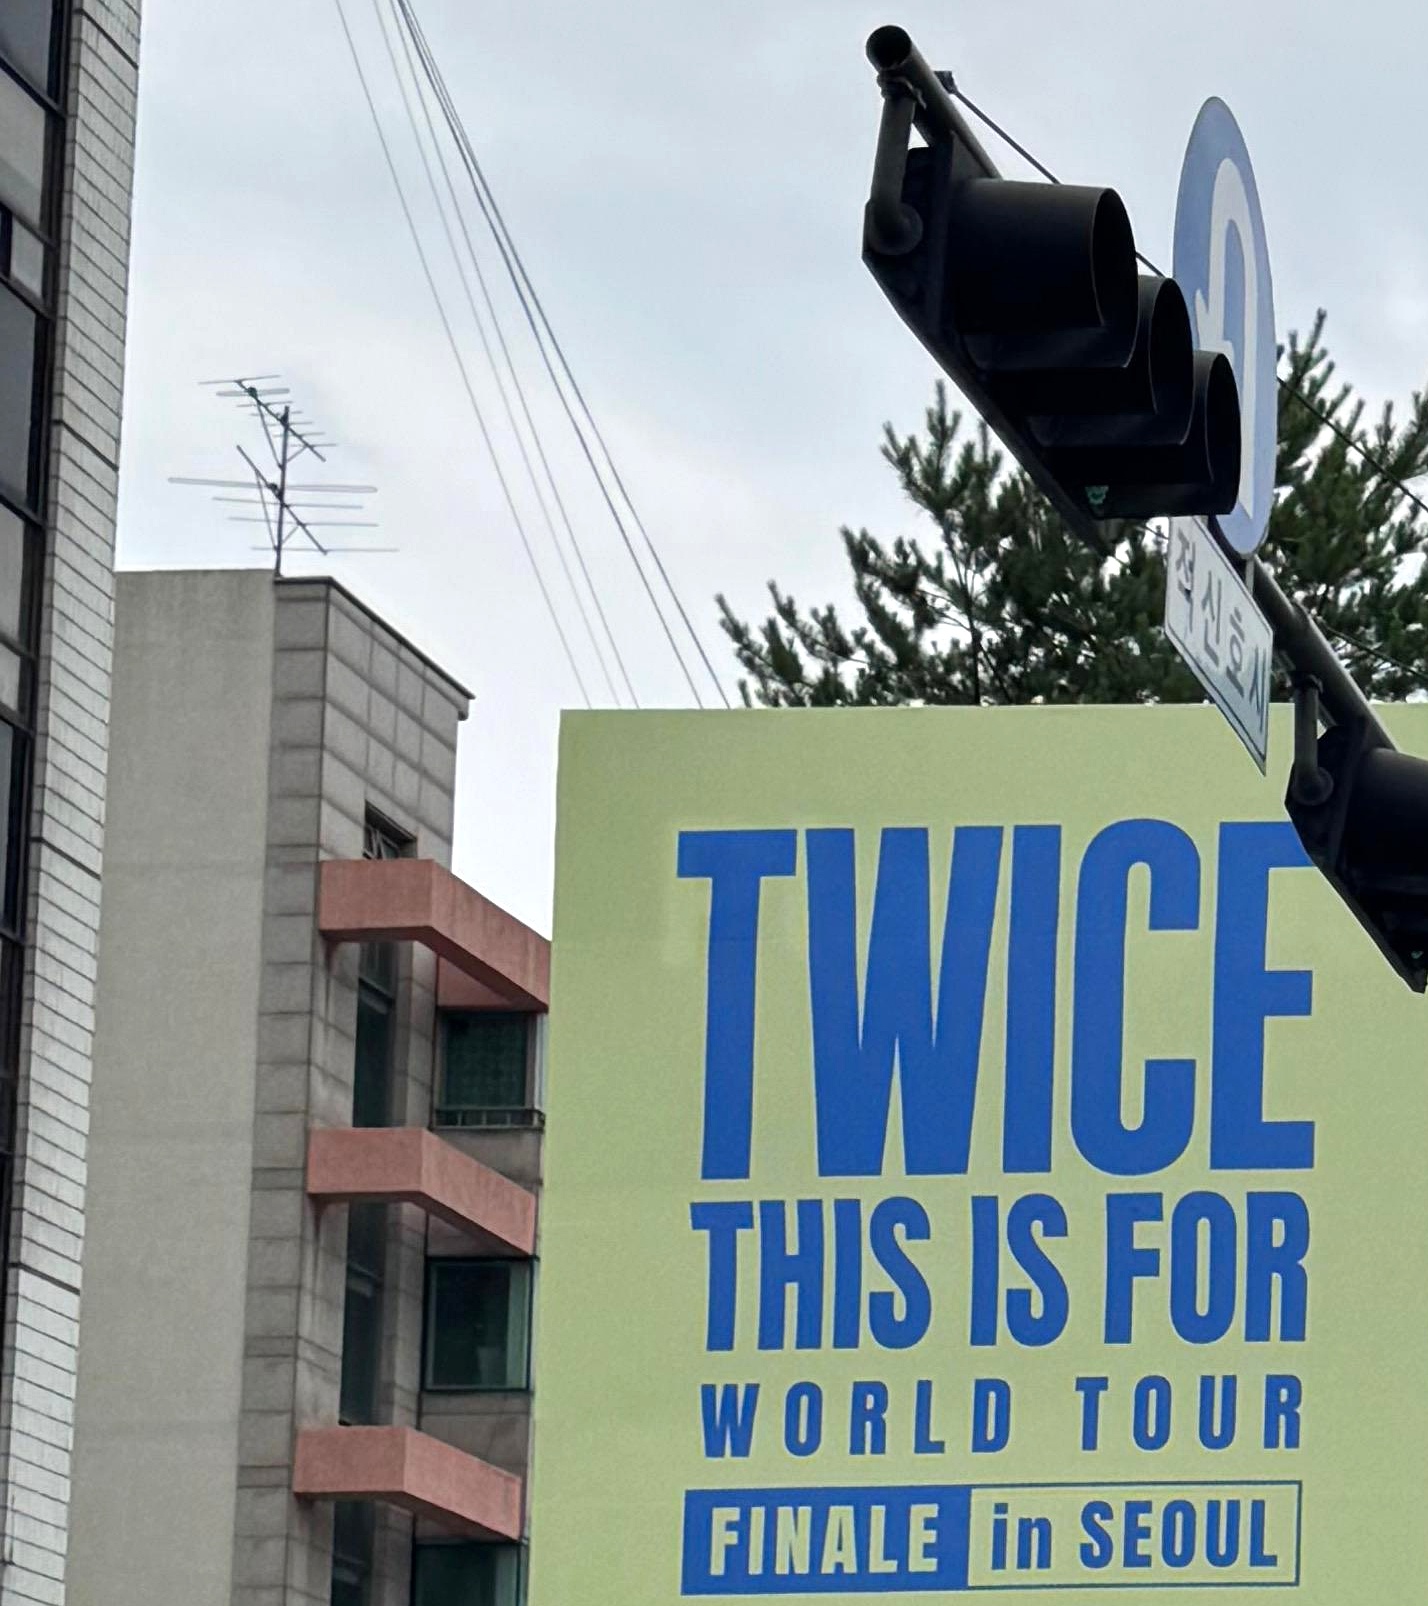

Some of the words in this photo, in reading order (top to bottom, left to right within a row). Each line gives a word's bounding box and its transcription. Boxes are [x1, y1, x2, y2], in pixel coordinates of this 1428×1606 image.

[677, 819, 1315, 1180] TWICE
[690, 1196, 931, 1352] THIS
[970, 1193, 1069, 1348] IS
[1105, 1190, 1310, 1345] FOR
[701, 1378, 1011, 1458] WORLD
[1075, 1374, 1302, 1452] TOUR
[709, 1504, 939, 1577] FINALE
[991, 1503, 1052, 1571] in
[1079, 1499, 1278, 1569] SEOUL
